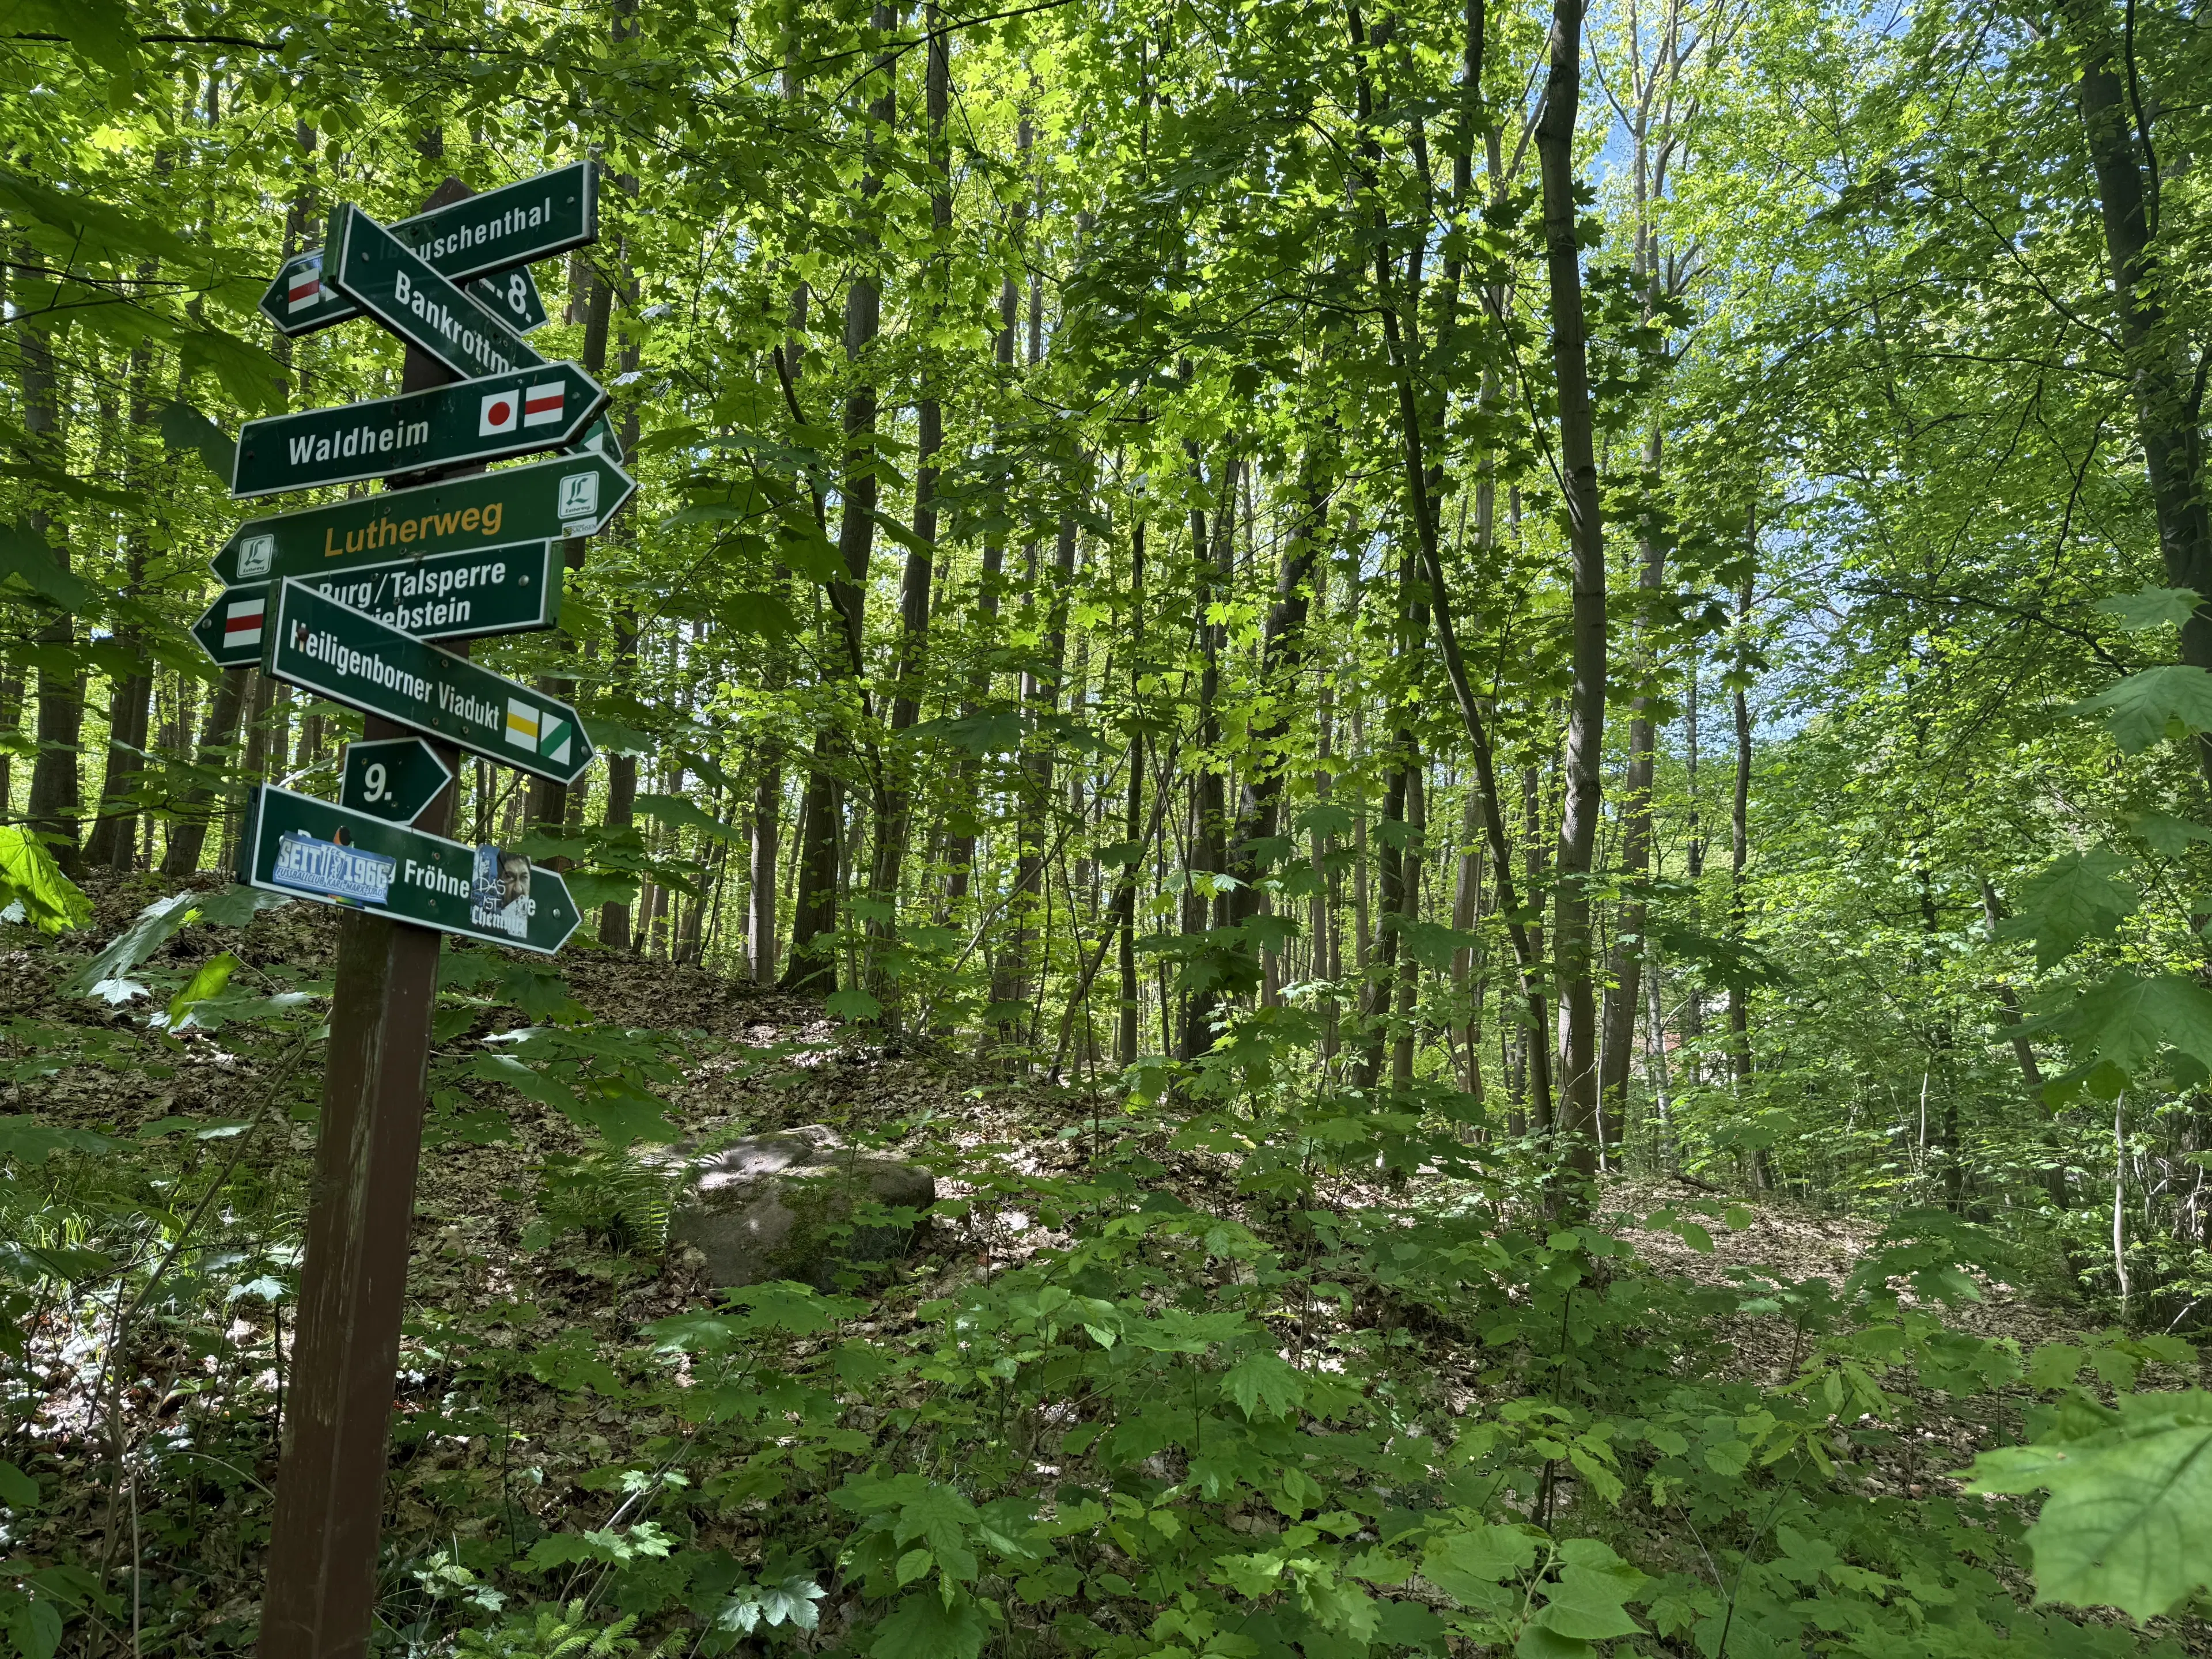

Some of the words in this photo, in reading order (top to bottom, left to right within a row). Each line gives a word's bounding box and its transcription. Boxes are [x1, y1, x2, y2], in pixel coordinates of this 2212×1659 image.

[409, 197, 550, 261] uschenthal
[395, 270, 520, 374] Bankrottm
[289, 420, 429, 465] Waldheim
[324, 502, 503, 558] Lutherweg
[571, 524, 597, 533] SACHSEN
[290, 619, 433, 703] Heiligenborner
[438, 681, 499, 731] Viadukt
[363, 763, 392, 802] 9.
[276, 867, 325, 885] FUSSBALLCLUB
[327, 878, 387, 897] KARL-MARX-STADT
[278, 840, 321, 874] SEIT
[343, 856, 390, 889] 1966
[474, 876, 506, 895] DAS
[483, 895, 502, 912] IST
